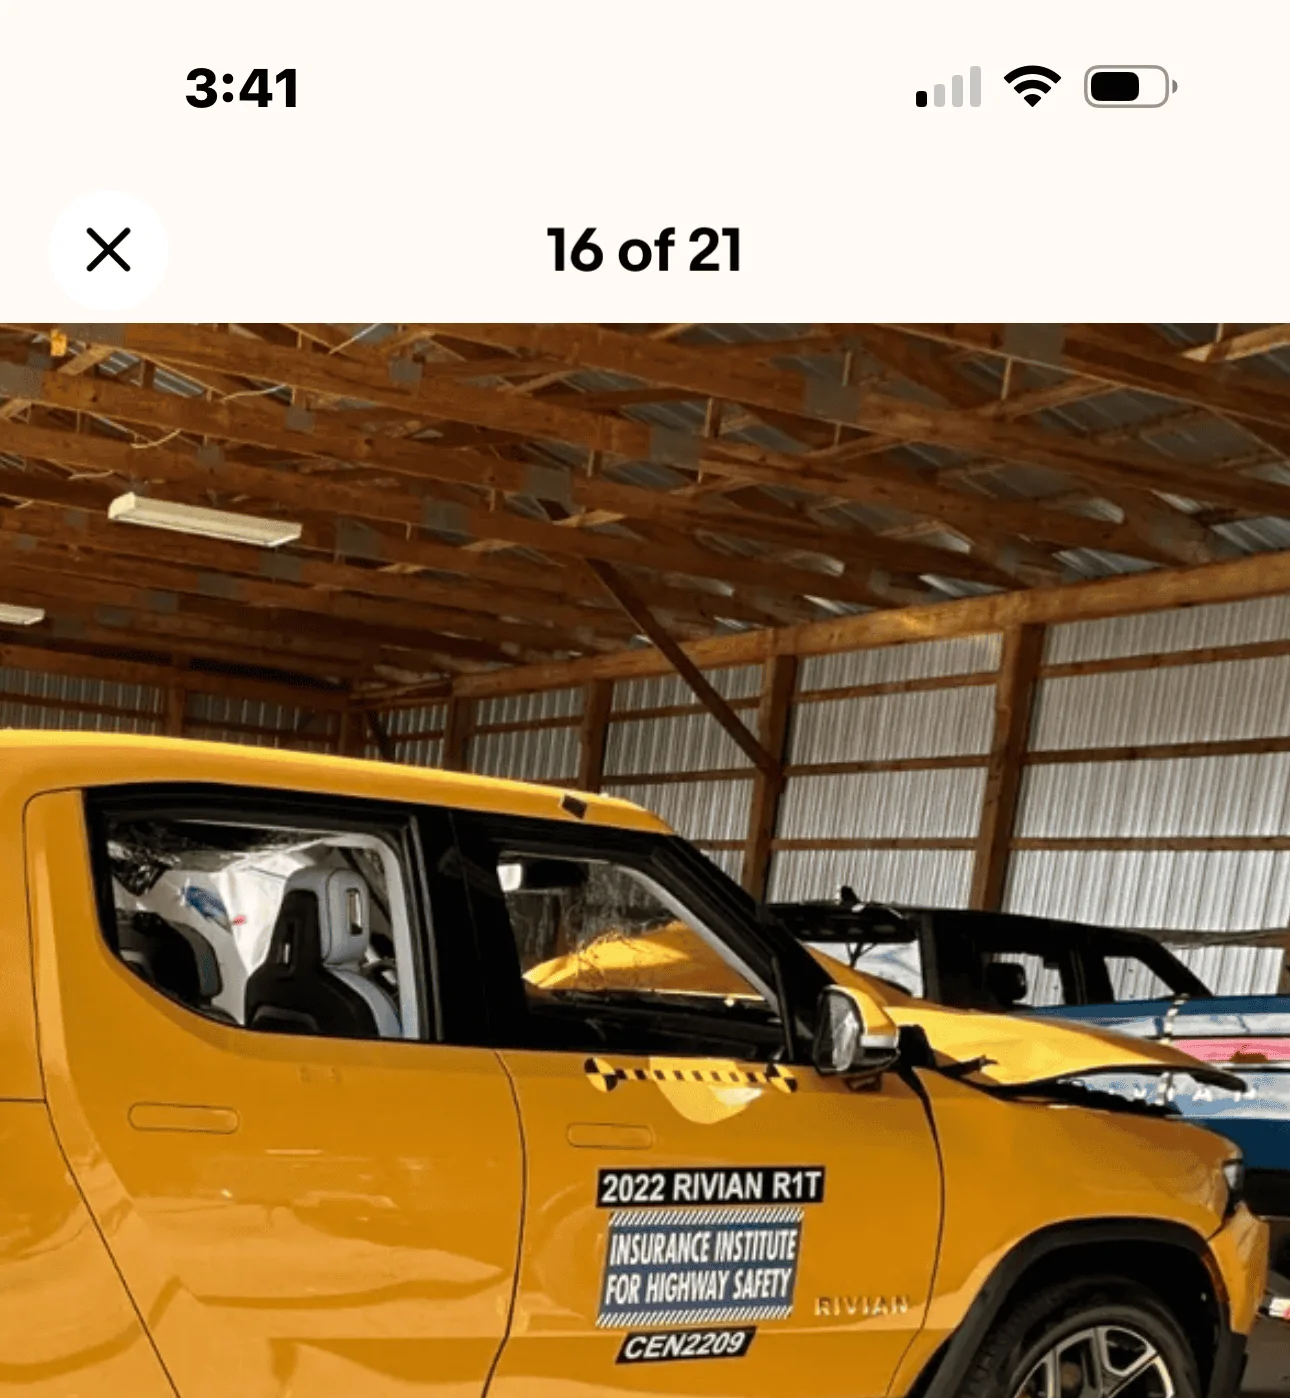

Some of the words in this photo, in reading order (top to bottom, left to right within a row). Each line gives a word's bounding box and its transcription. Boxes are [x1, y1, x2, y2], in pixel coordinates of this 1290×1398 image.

[601, 1172, 664, 1203] 2022
[673, 1171, 763, 1201] RIVIAN
[772, 1170, 821, 1199] R1T
[609, 1231, 710, 1266] INSURANCE
[714, 1228, 798, 1263] INSTITUTE
[605, 1273, 640, 1306] FOR
[645, 1269, 730, 1303] HIGHWAY
[733, 1267, 793, 1299] SAFETY
[814, 1296, 908, 1316] RIVIAN
[624, 1330, 746, 1361] CEN2209
